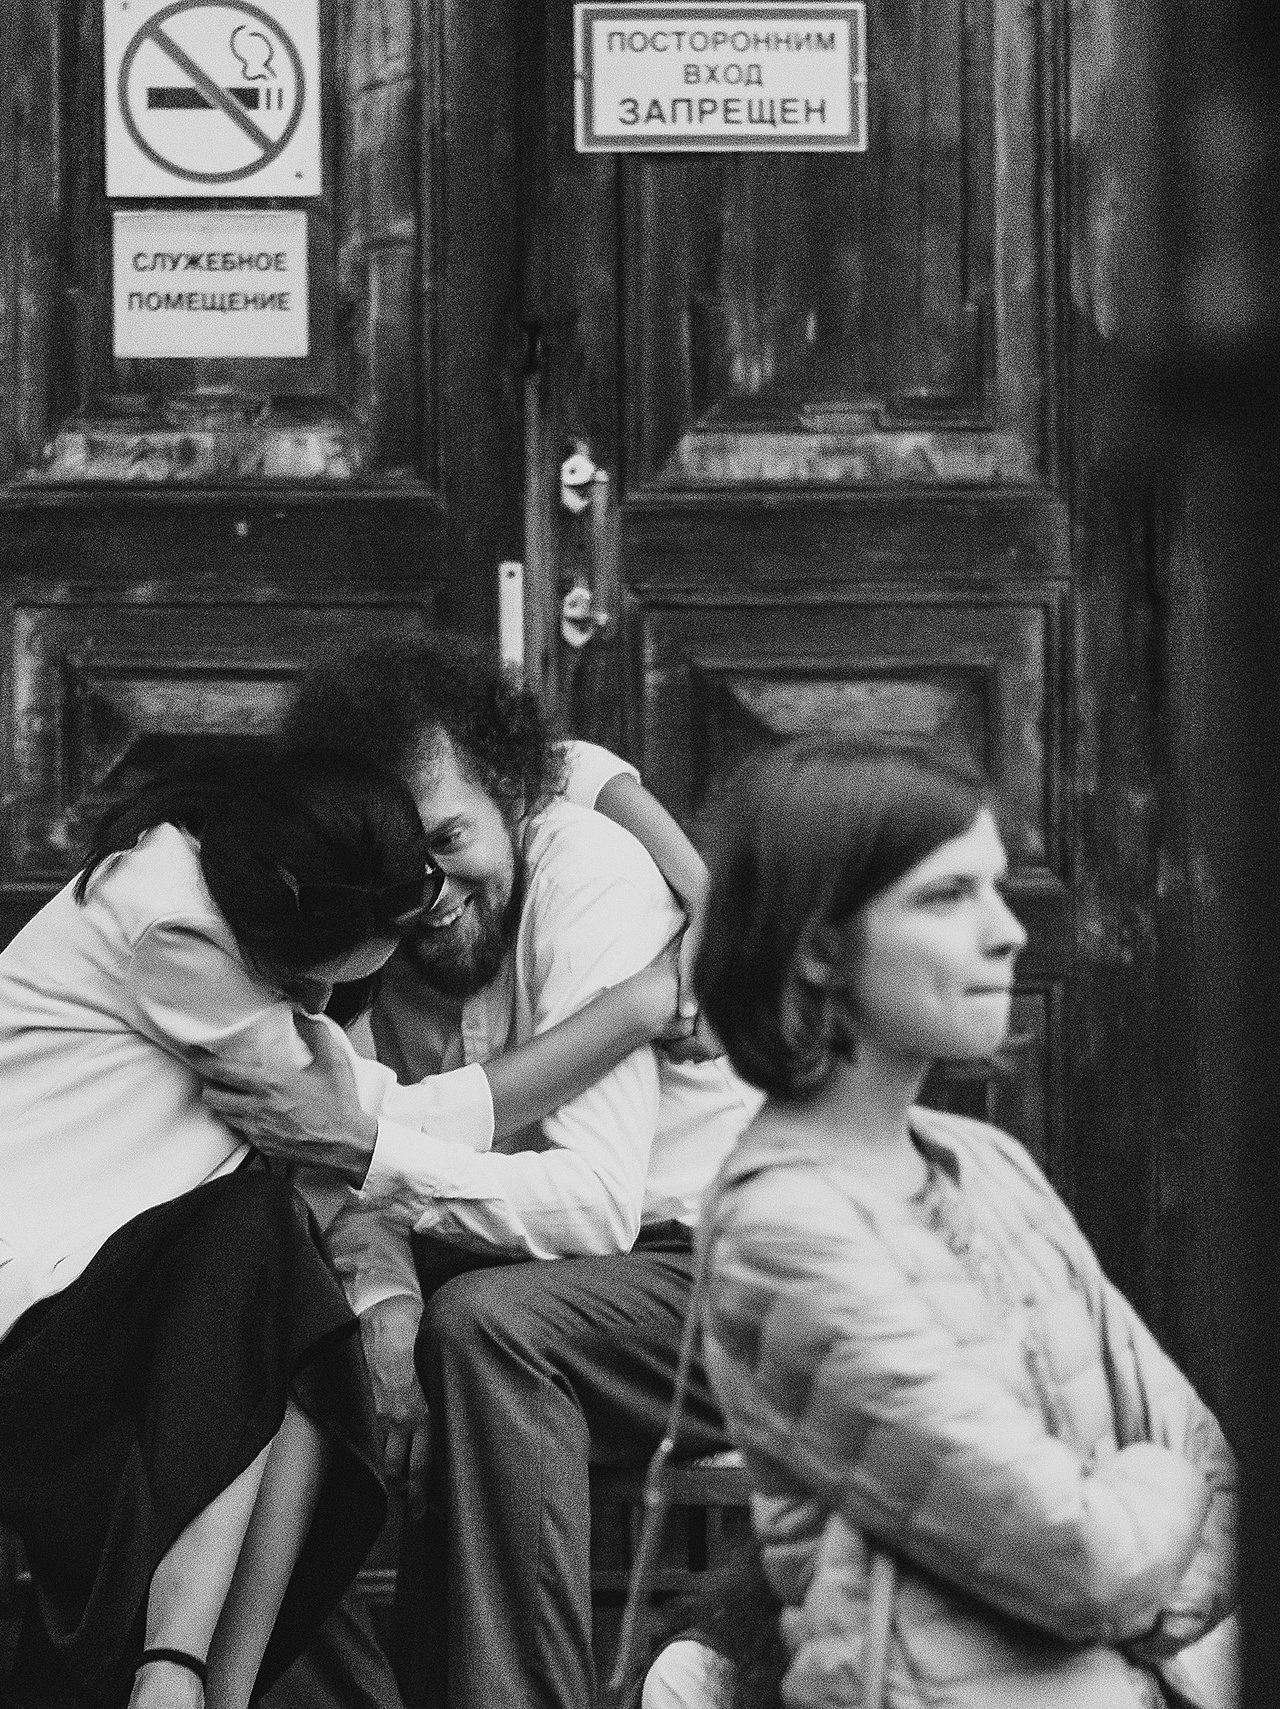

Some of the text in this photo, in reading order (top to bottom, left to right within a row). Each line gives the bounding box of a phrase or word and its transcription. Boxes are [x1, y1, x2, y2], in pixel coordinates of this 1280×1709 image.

[607, 30, 836, 52] ПОСТОРОННИМ
[683, 63, 763, 87] ВХОД
[618, 97, 827, 128] ЗАПРЕЩЕН
[132, 251, 287, 272] СЛУЖЕБНОЕ
[128, 291, 290, 313] ПОМЕЩЕНИЕ
